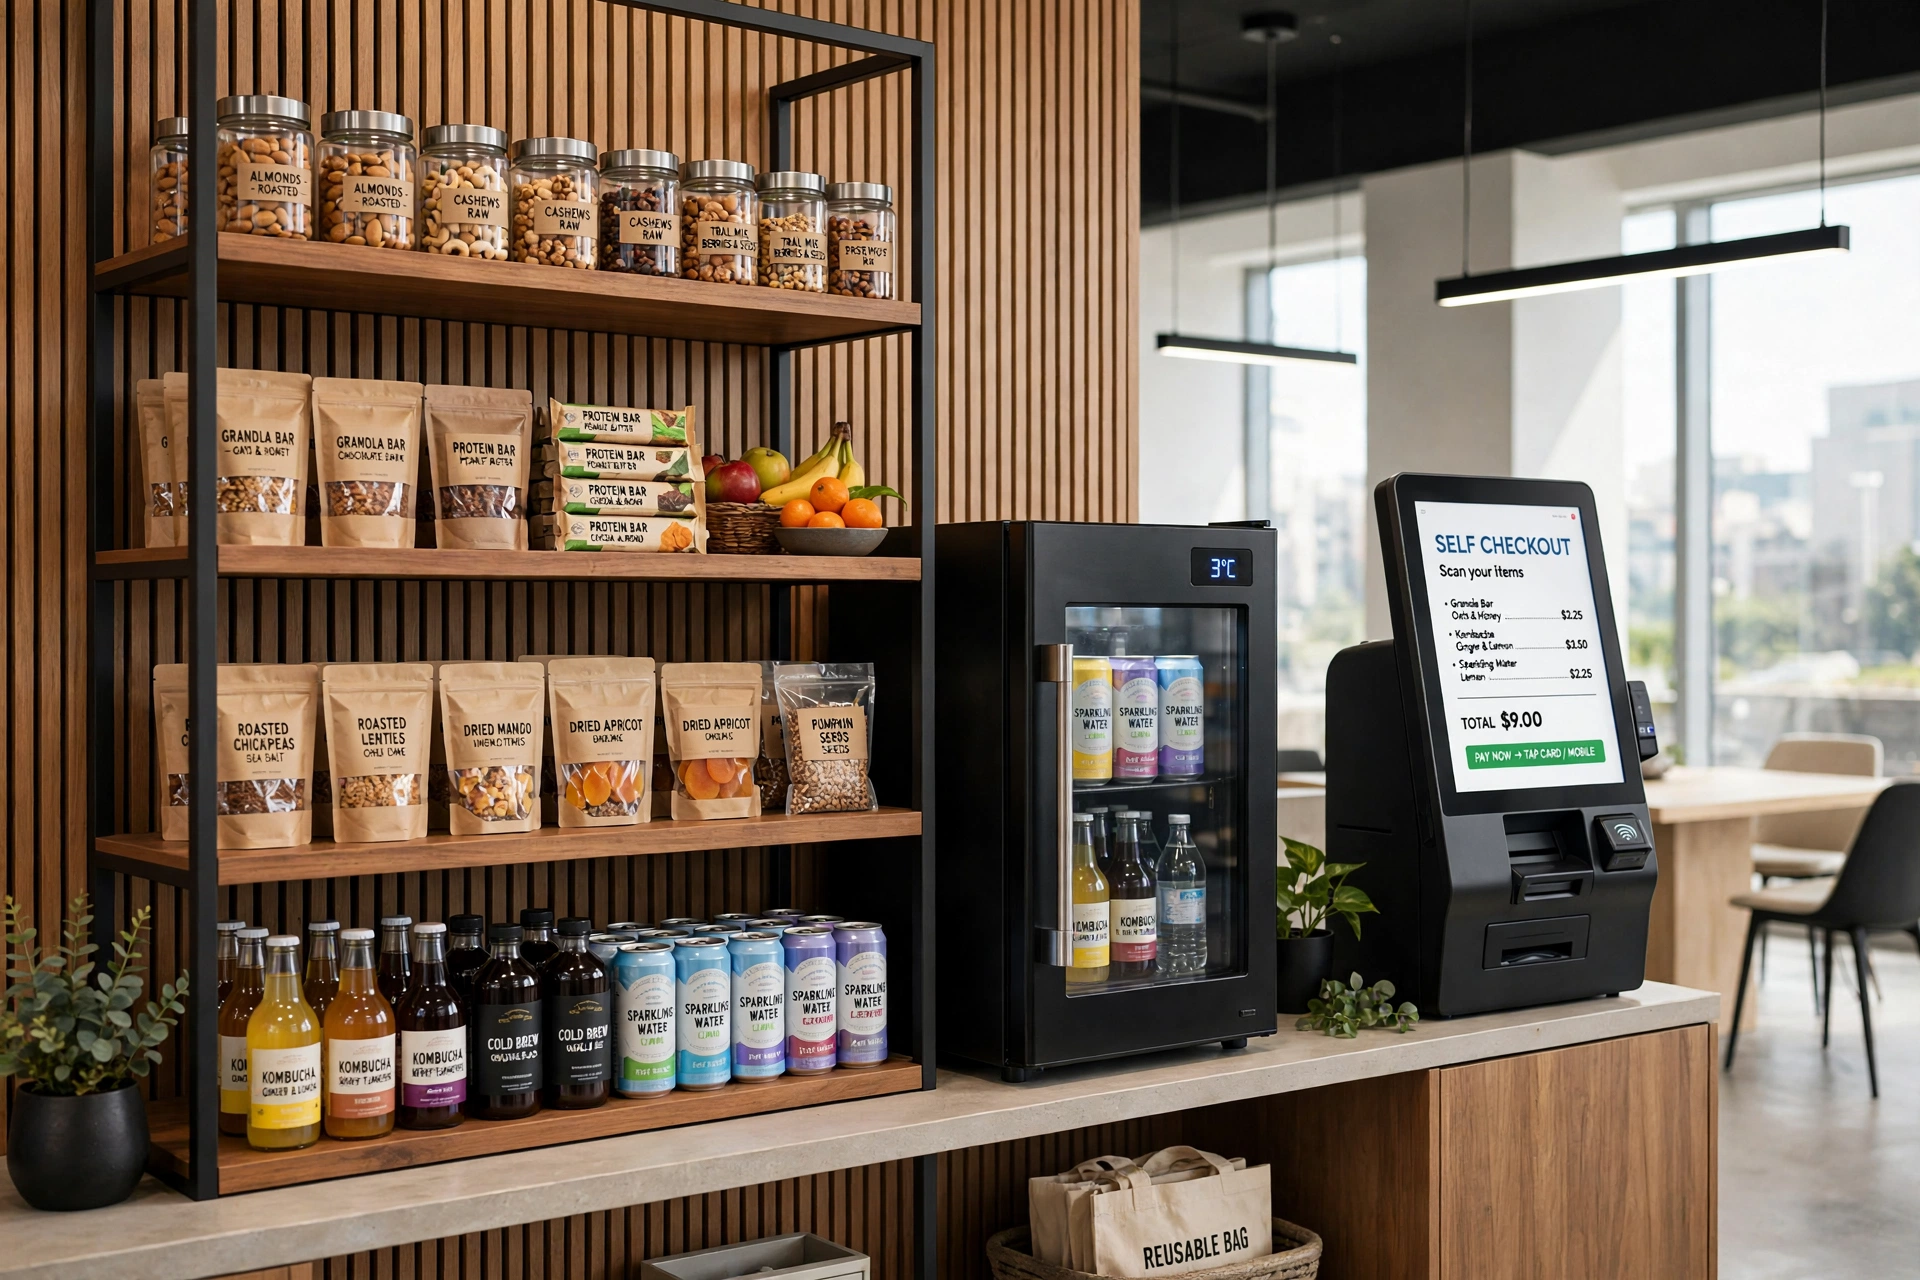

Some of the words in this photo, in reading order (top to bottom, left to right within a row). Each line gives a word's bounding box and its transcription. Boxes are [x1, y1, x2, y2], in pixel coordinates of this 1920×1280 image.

[250, 170, 301, 185] ALMONDS
[258, 184, 298, 197] ROASTED
[354, 183, 403, 197] ALMONDS
[362, 196, 400, 208] ROASTED
[454, 194, 500, 208] CASHEWS
[468, 208, 490, 219] RAW
[544, 206, 591, 220] CASHEWS
[560, 220, 580, 231] RAW
[629, 217, 672, 230] CASHEWS
[642, 230, 663, 240] RAW
[623, 413, 641, 423] BAR
[275, 432, 295, 446] BAR
[388, 438, 406, 451] BAR
[452, 442, 494, 455] PROTEIN
[498, 444, 516, 456] BAR
[586, 448, 624, 460] PROTEIN
[627, 450, 646, 460] BAR
[588, 484, 626, 496] PROTEIN
[630, 486, 647, 496] BAR
[590, 521, 628, 532] PROTEIN
[630, 522, 648, 532] BAR
[1435, 534, 1476, 554] SELF
[1480, 536, 1571, 556] CHECKOUT
[1439, 564, 1466, 578] Scan
[1468, 566, 1492, 581] your
[1561, 610, 1583, 620] $2.25
[1570, 668, 1592, 680] $2.25
[358, 716, 406, 730] ROASTED
[570, 720, 600, 733] DRIED
[682, 718, 711, 732] DRIED
[1461, 716, 1496, 730] TOTAL
[1500, 710, 1543, 731] $9.00
[238, 722, 289, 736] ROASTED
[464, 723, 495, 737] DRIED
[234, 738, 295, 752] CHICKPEAS
[1474, 752, 1490, 763] PAY
[1492, 750, 1512, 762] NOW
[1524, 748, 1538, 759] TAP
[1540, 748, 1561, 758] CARD
[1568, 746, 1596, 758] MOBILE
[558, 1028, 584, 1042] COLD
[488, 1037, 513, 1050] COLD
[412, 1048, 463, 1065] KOMBUCHA
[338, 1058, 392, 1074] KOMBUCHA
[262, 1067, 316, 1084] KOMBUCHA
[1143, 1234, 1220, 1270] REUSABLE
[1223, 1226, 1249, 1254] BAG
